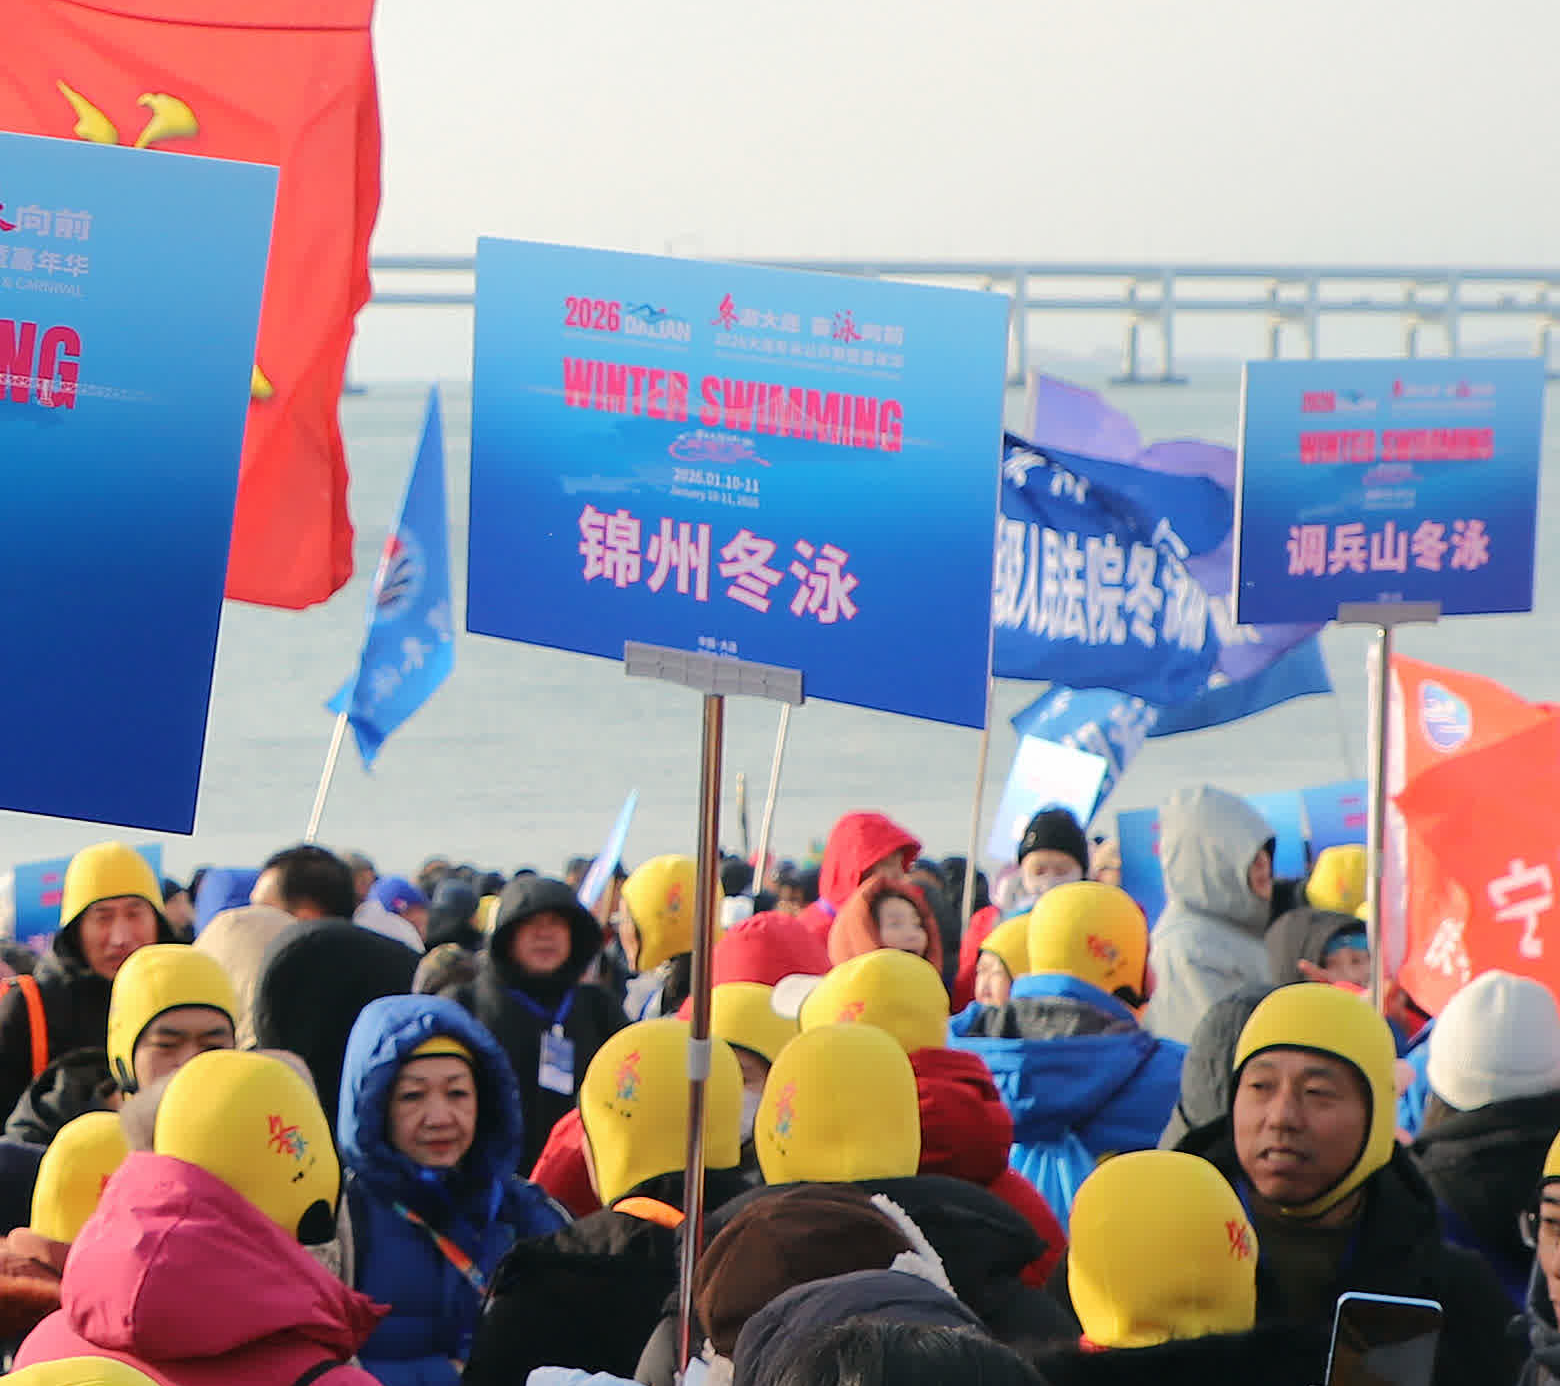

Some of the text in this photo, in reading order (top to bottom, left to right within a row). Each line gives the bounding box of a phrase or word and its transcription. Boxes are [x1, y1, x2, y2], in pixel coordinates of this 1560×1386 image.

[564, 295, 622, 332] 2026
[562, 356, 689, 423] WINTER
[699, 375, 904, 453] SWIMMING
[578, 504, 859, 625] 锦州冬泳
[1286, 519, 1491, 577] 调兵山冬泳
